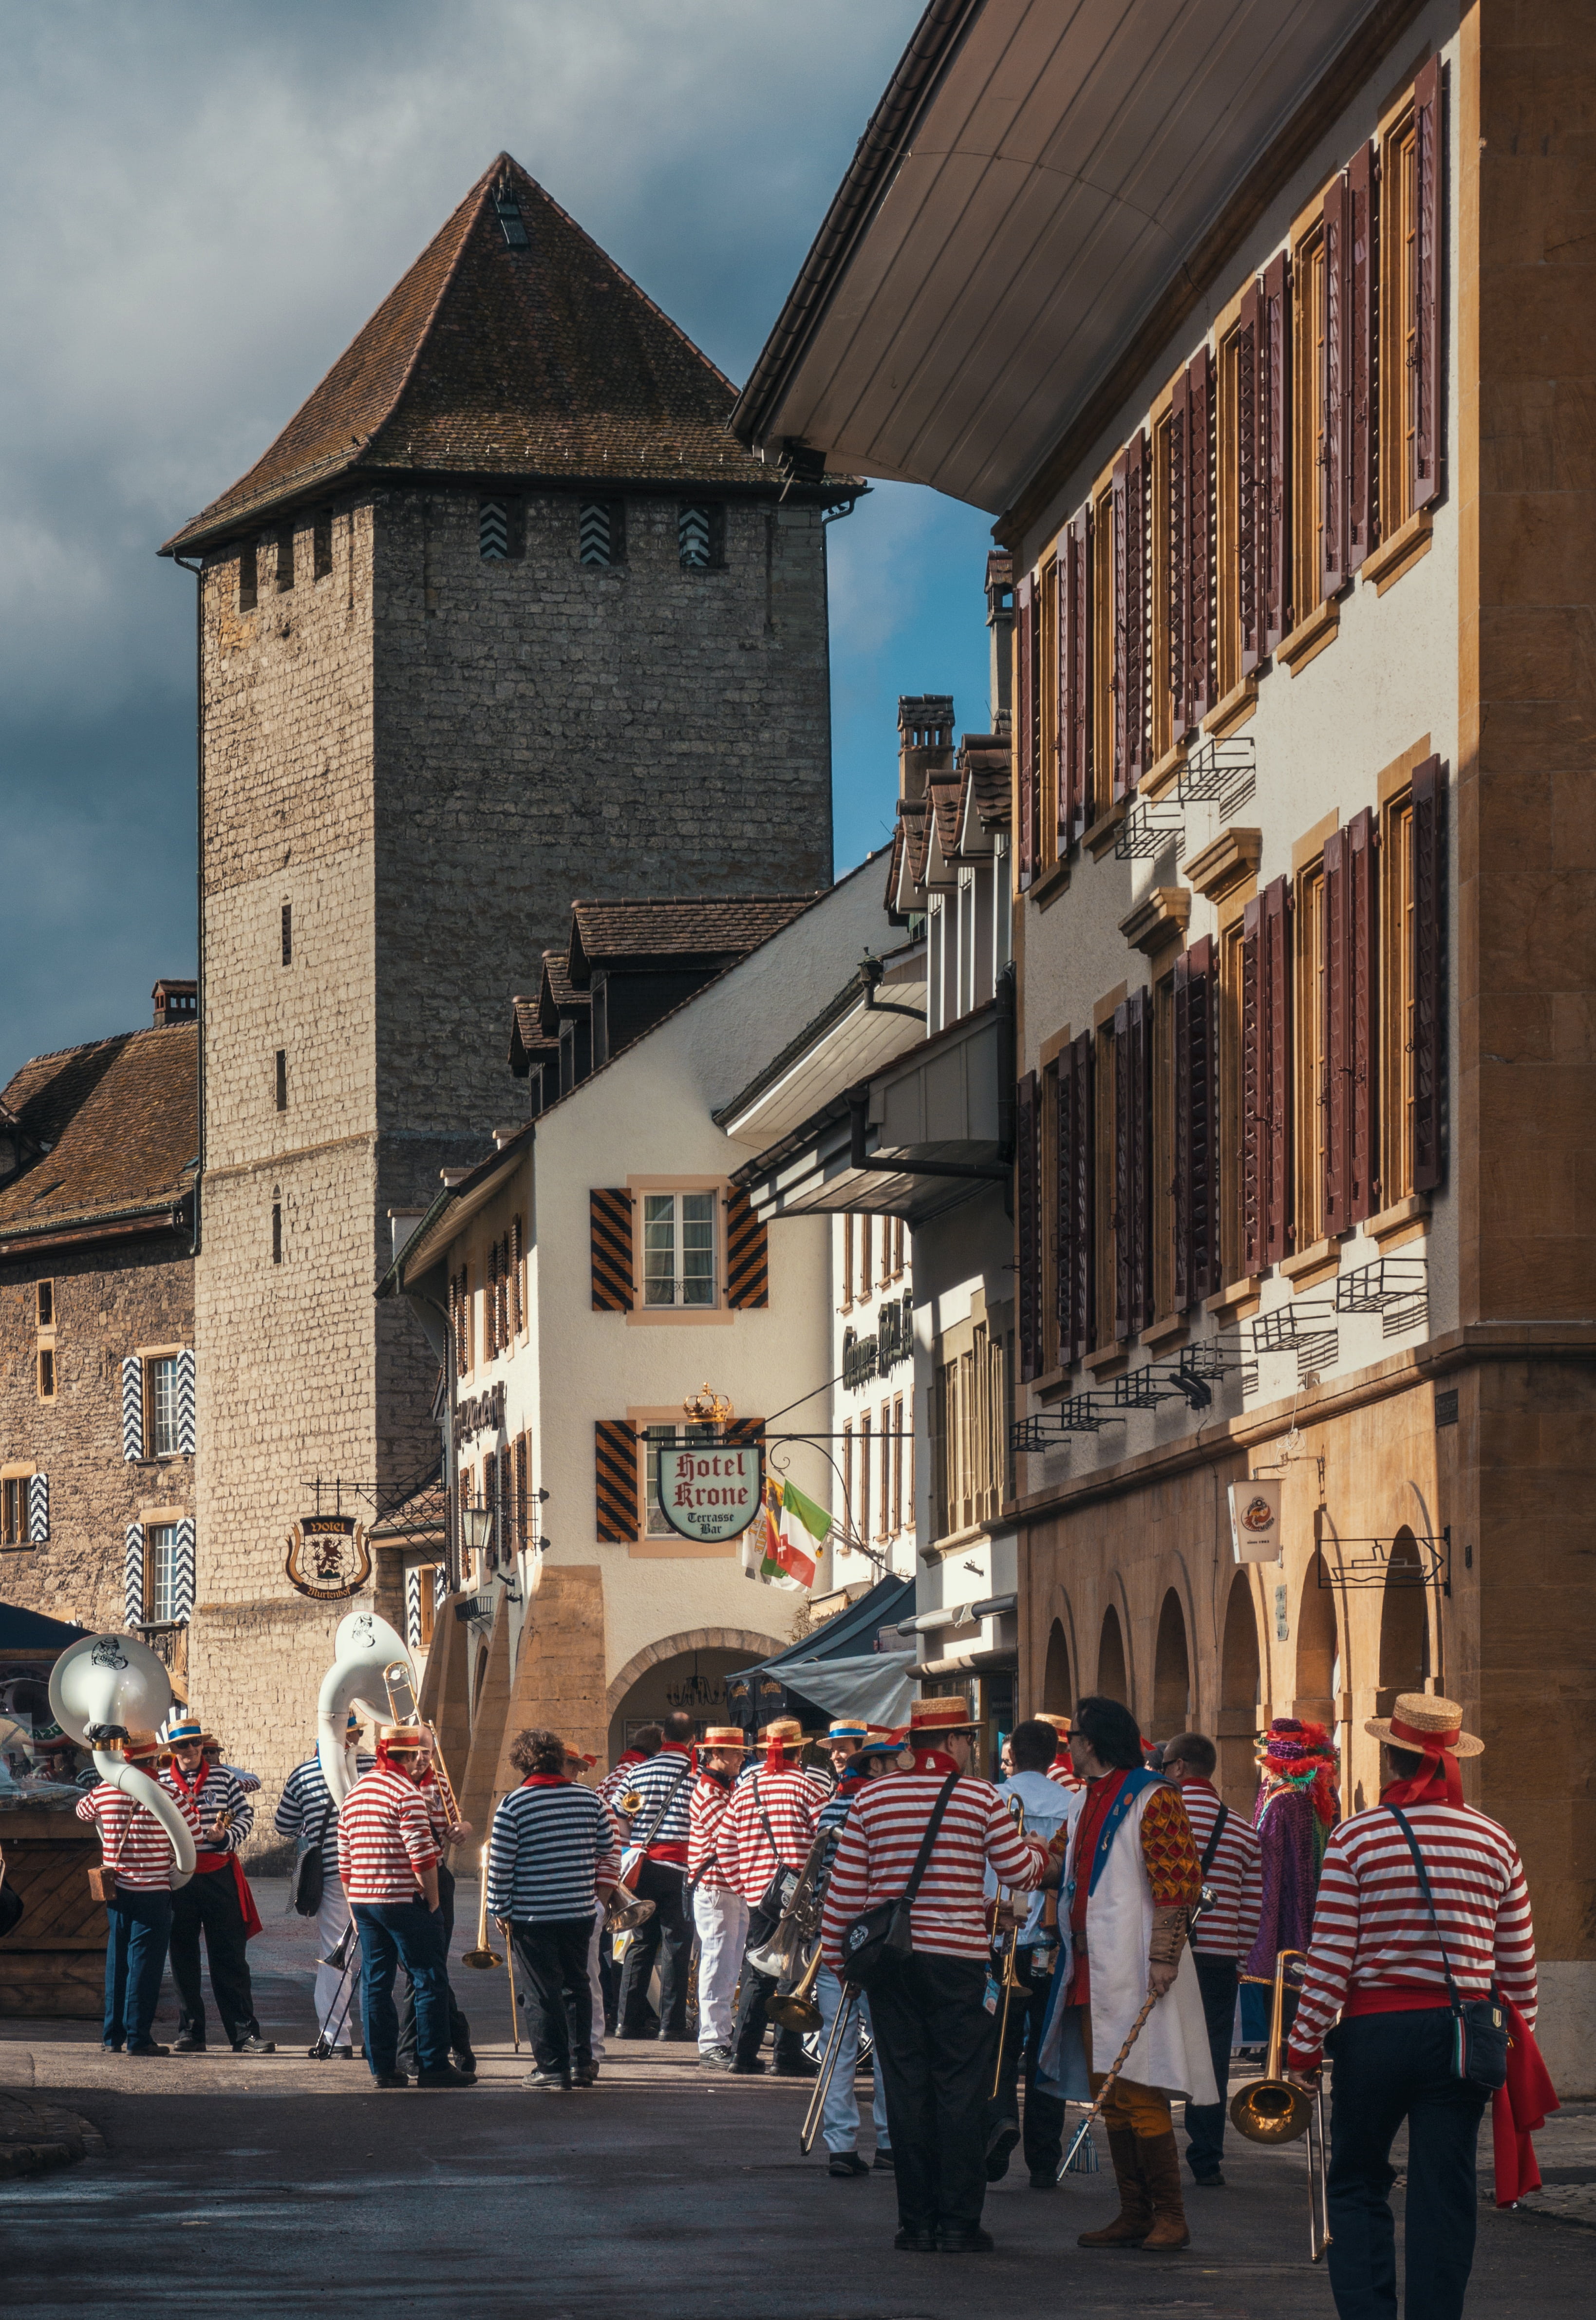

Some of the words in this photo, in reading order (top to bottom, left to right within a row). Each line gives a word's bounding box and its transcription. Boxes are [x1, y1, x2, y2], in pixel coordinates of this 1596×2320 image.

[674, 1452, 747, 1482] Hotel
[672, 1481, 749, 1509] Krone
[687, 1512, 734, 1523] Terrasse
[311, 1522, 345, 1532] Hotel
[700, 1523, 722, 1536] Bar
[307, 1586, 351, 1599] Murtenhof
